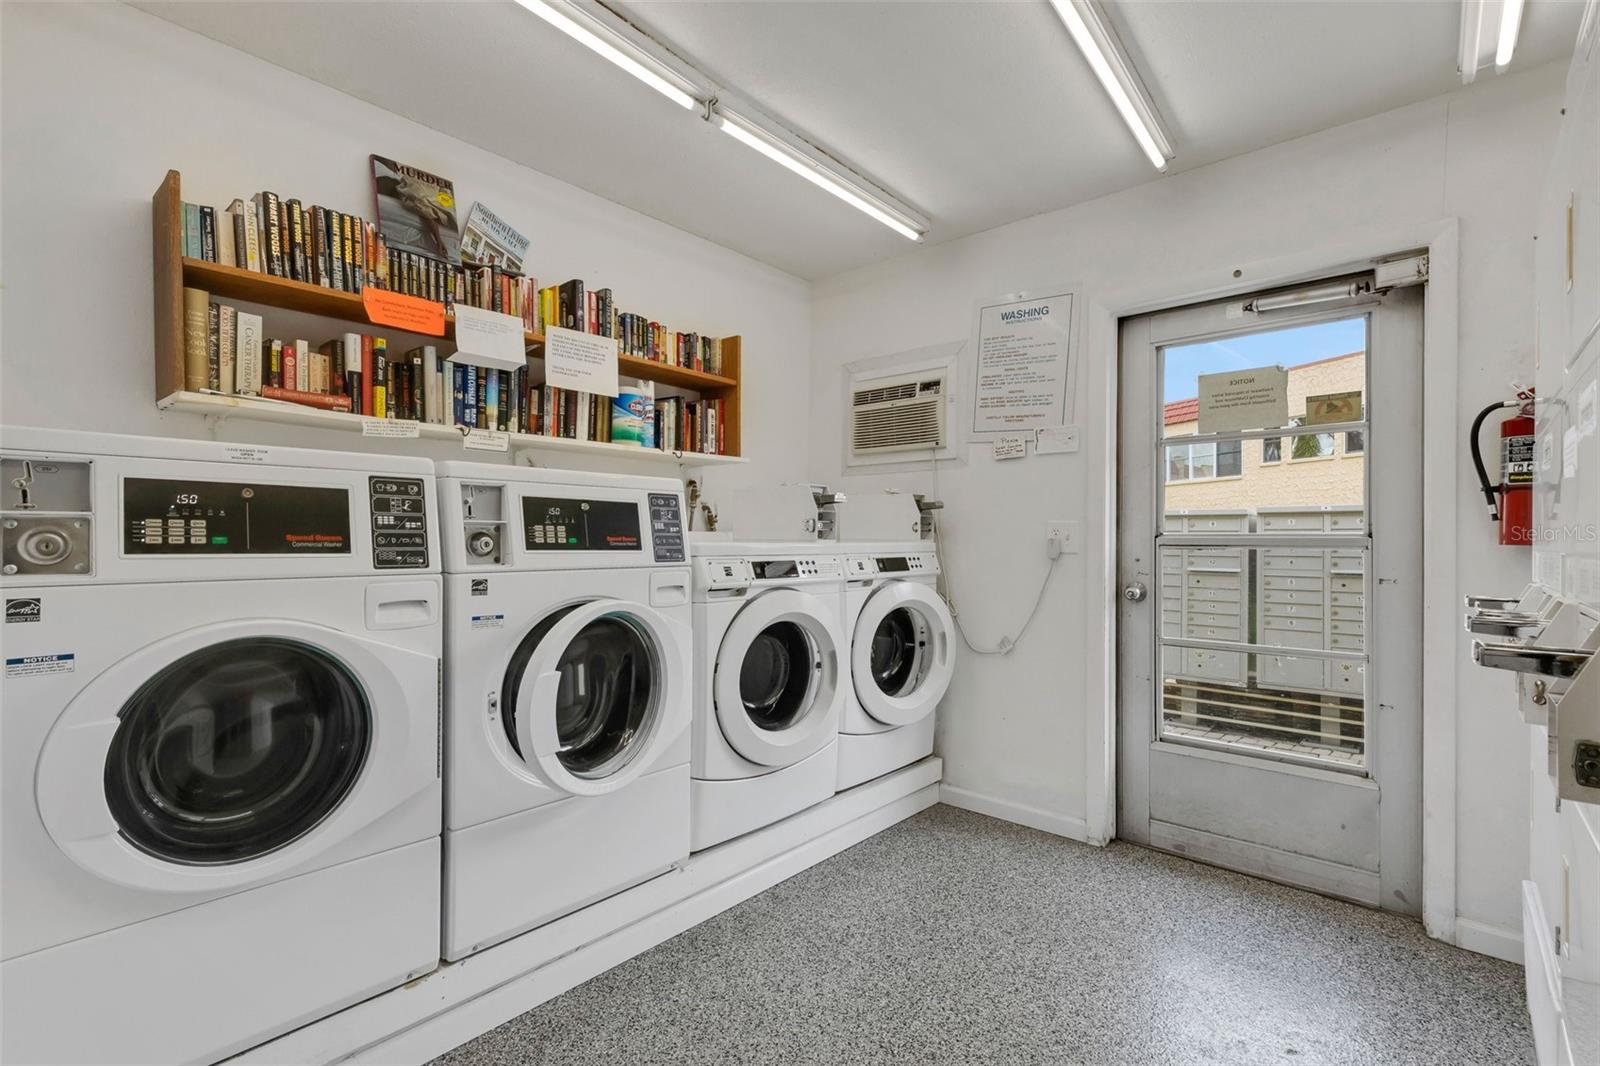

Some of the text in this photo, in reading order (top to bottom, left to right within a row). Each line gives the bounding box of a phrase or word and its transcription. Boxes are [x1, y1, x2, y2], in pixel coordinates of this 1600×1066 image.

[394, 163, 453, 190] MURDER
[269, 194, 280, 256] STUART WOODS
[1001, 306, 1049, 320] WASHING
[244, 328, 254, 357] CANCER
